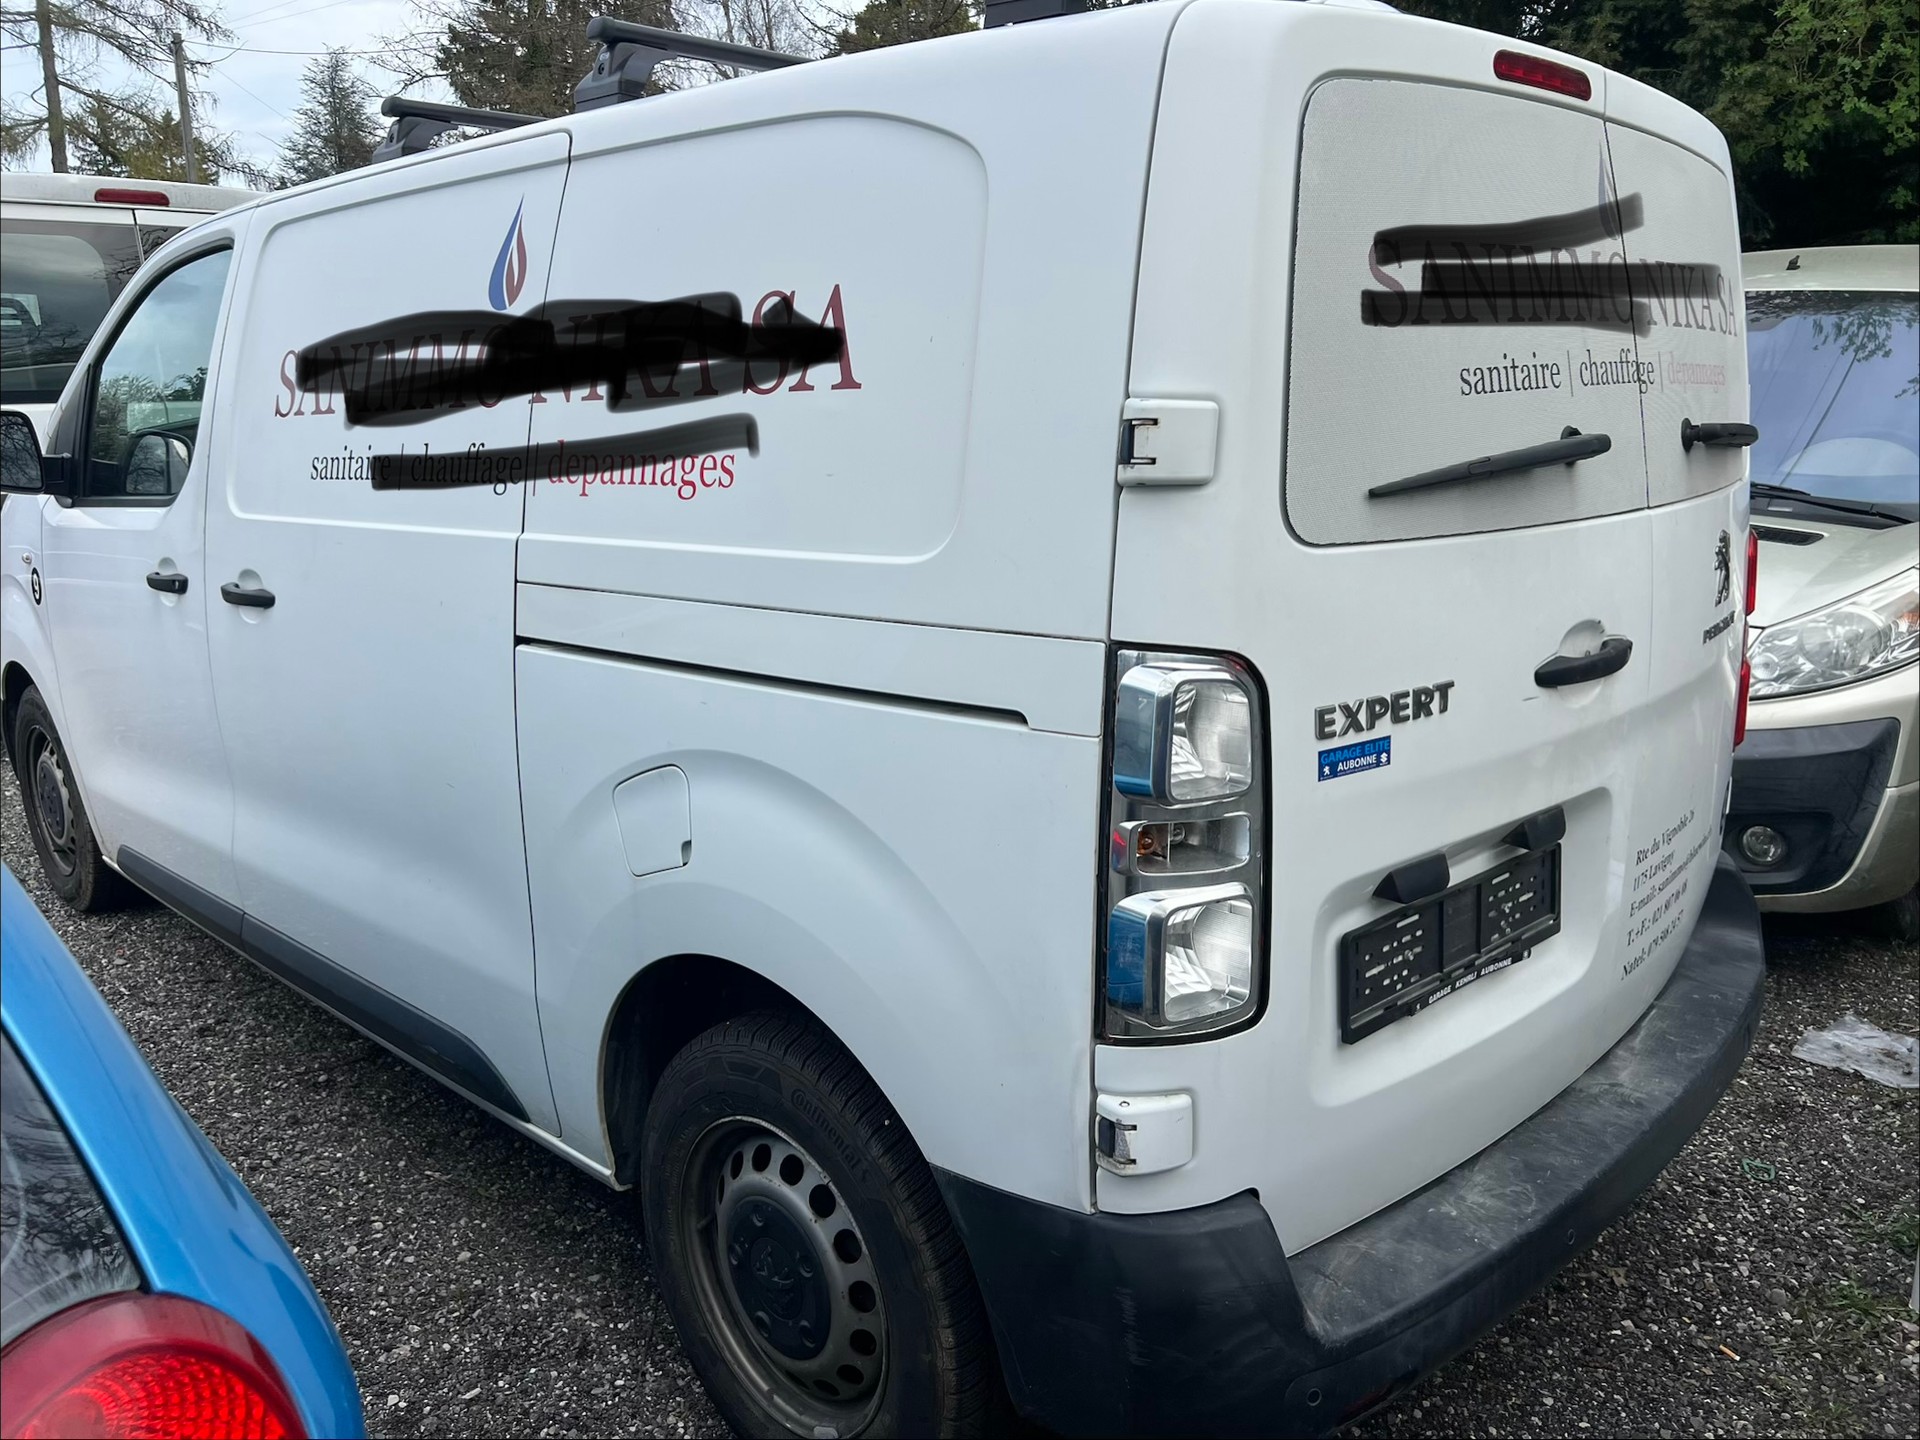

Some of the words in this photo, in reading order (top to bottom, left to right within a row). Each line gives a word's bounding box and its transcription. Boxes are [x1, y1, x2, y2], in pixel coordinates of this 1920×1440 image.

[1459, 352, 1562, 396] sanitaire
[1579, 348, 1655, 395] chauffage
[310, 444, 392, 481] sanitaire
[411, 441, 523, 496] chauffage
[547, 439, 736, 501] depannages
[1314, 679, 1455, 741] EXPERT
[1321, 745, 1362, 765] GARAGE
[1364, 739, 1390, 755] ELITE
[1337, 753, 1378, 772] AUBONNE
[1635, 847, 1650, 867] Rte
[1428, 985, 1452, 1004] GARAGE
[1480, 957, 1513, 976] AUBONNE
[789, 1087, 863, 1171] Continental
